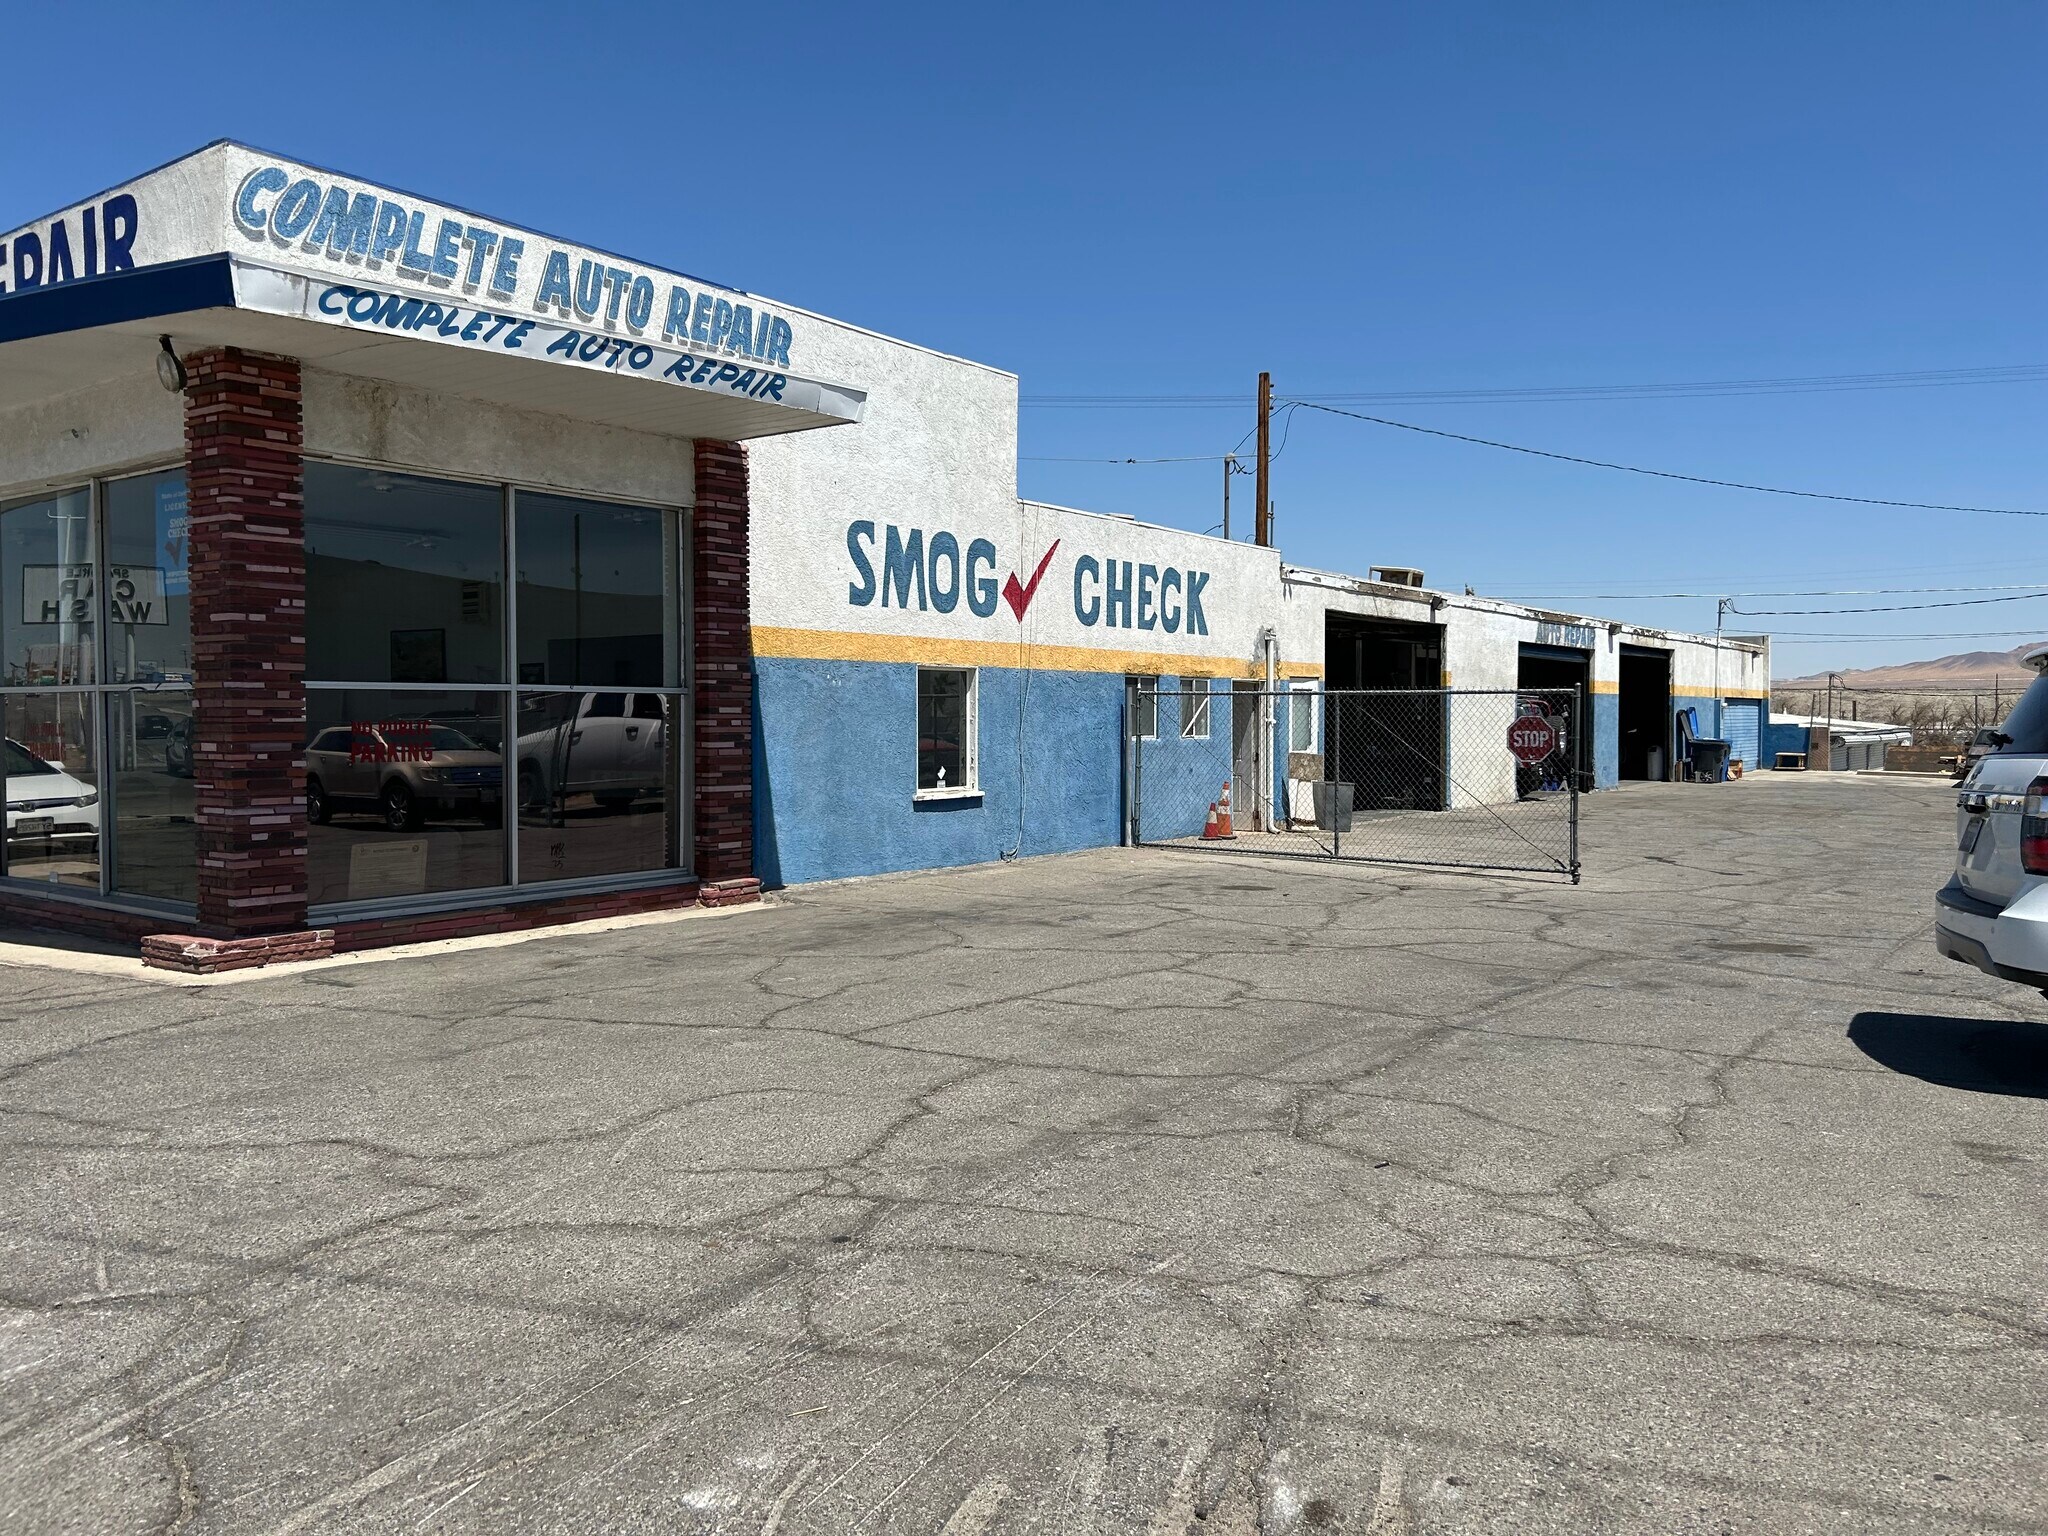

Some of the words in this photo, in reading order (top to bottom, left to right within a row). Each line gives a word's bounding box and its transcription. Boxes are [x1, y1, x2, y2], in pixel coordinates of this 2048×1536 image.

[233, 166, 525, 300] COMPLETE
[533, 249, 654, 336] AUTO
[661, 285, 793, 368] REPAIR
[318, 285, 536, 348] COMPLETE
[546, 330, 654, 369] AUTO
[663, 354, 788, 402] REPAIR
[846, 519, 998, 619] SMOG
[1073, 554, 1211, 636] CHECK
[1564, 625, 1595, 649] REPAIR
[351, 720, 372, 736] NO
[378, 719, 433, 736] PUBLIC
[1513, 730, 1549, 747] STOP
[351, 741, 433, 763] PARKING
